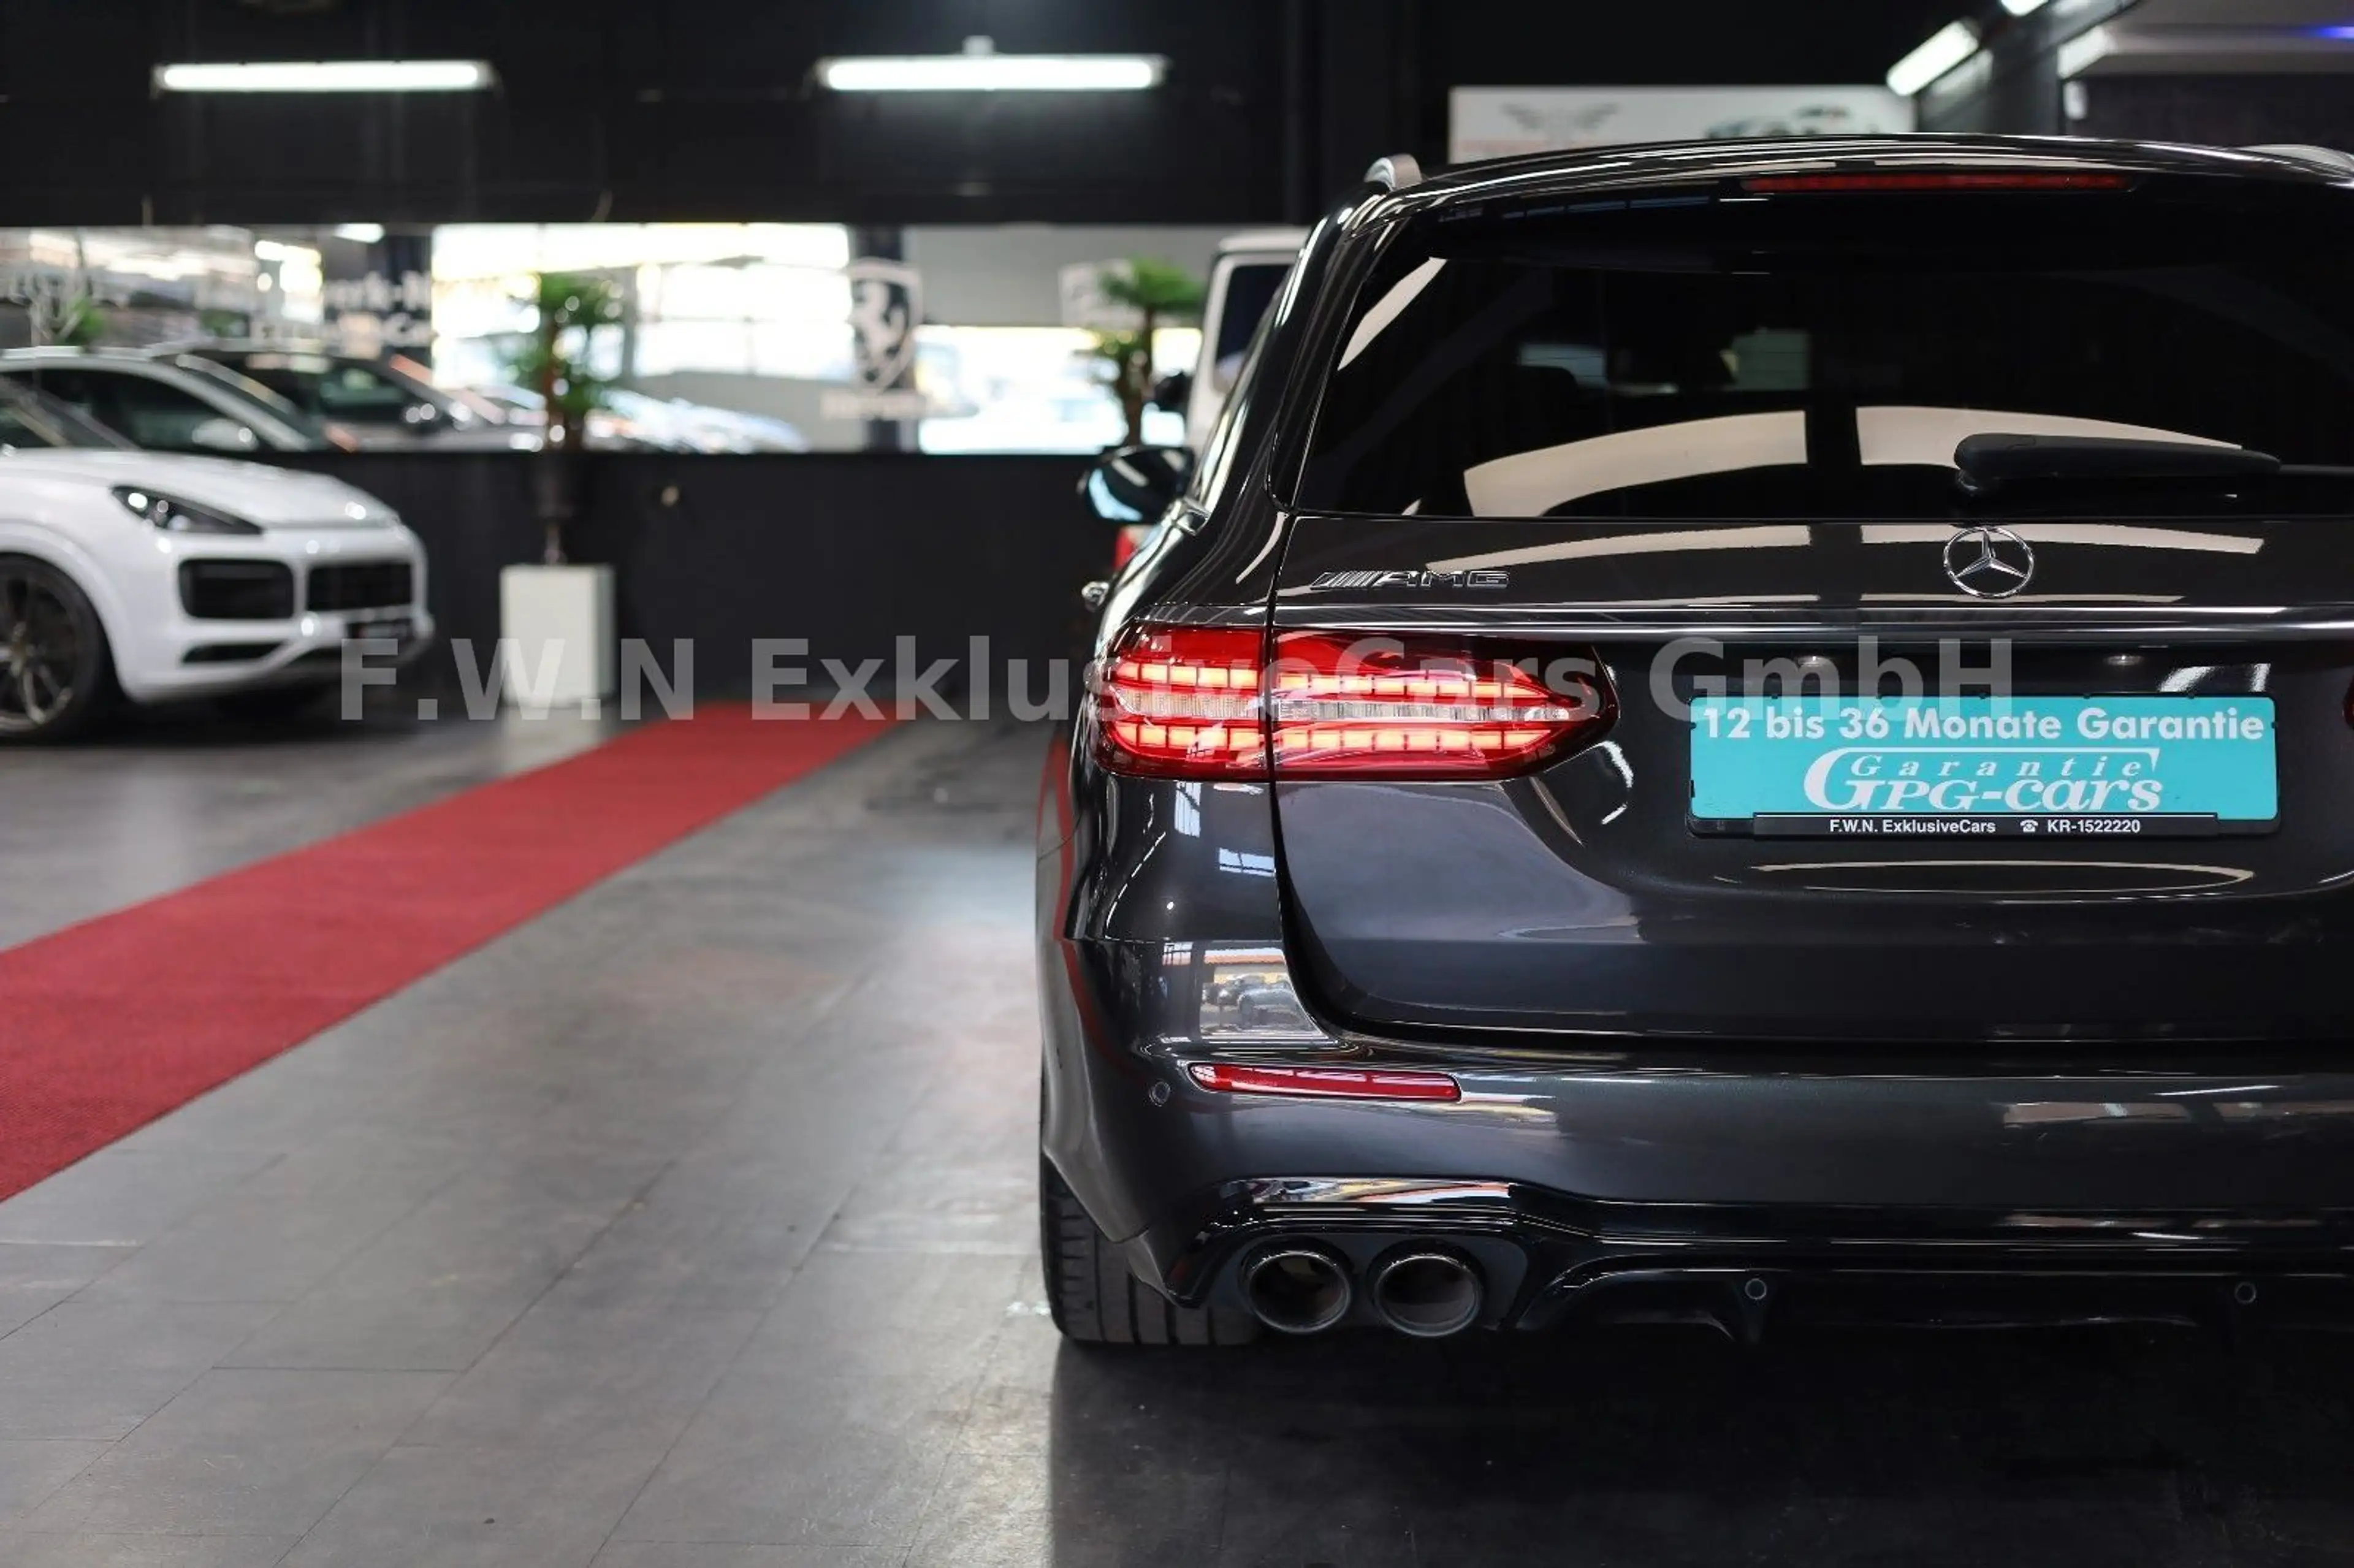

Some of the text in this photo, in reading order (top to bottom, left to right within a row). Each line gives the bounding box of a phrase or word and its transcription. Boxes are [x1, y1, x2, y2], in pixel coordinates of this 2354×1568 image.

[1371, 570, 1510, 588] AMG
[1703, 706, 2264, 740] 12 bis 36 Monate Garantie
[1850, 755, 2142, 777] Garantie
[1829, 818, 2141, 834] F.W.N. ExklusiveCars KR-1522220
